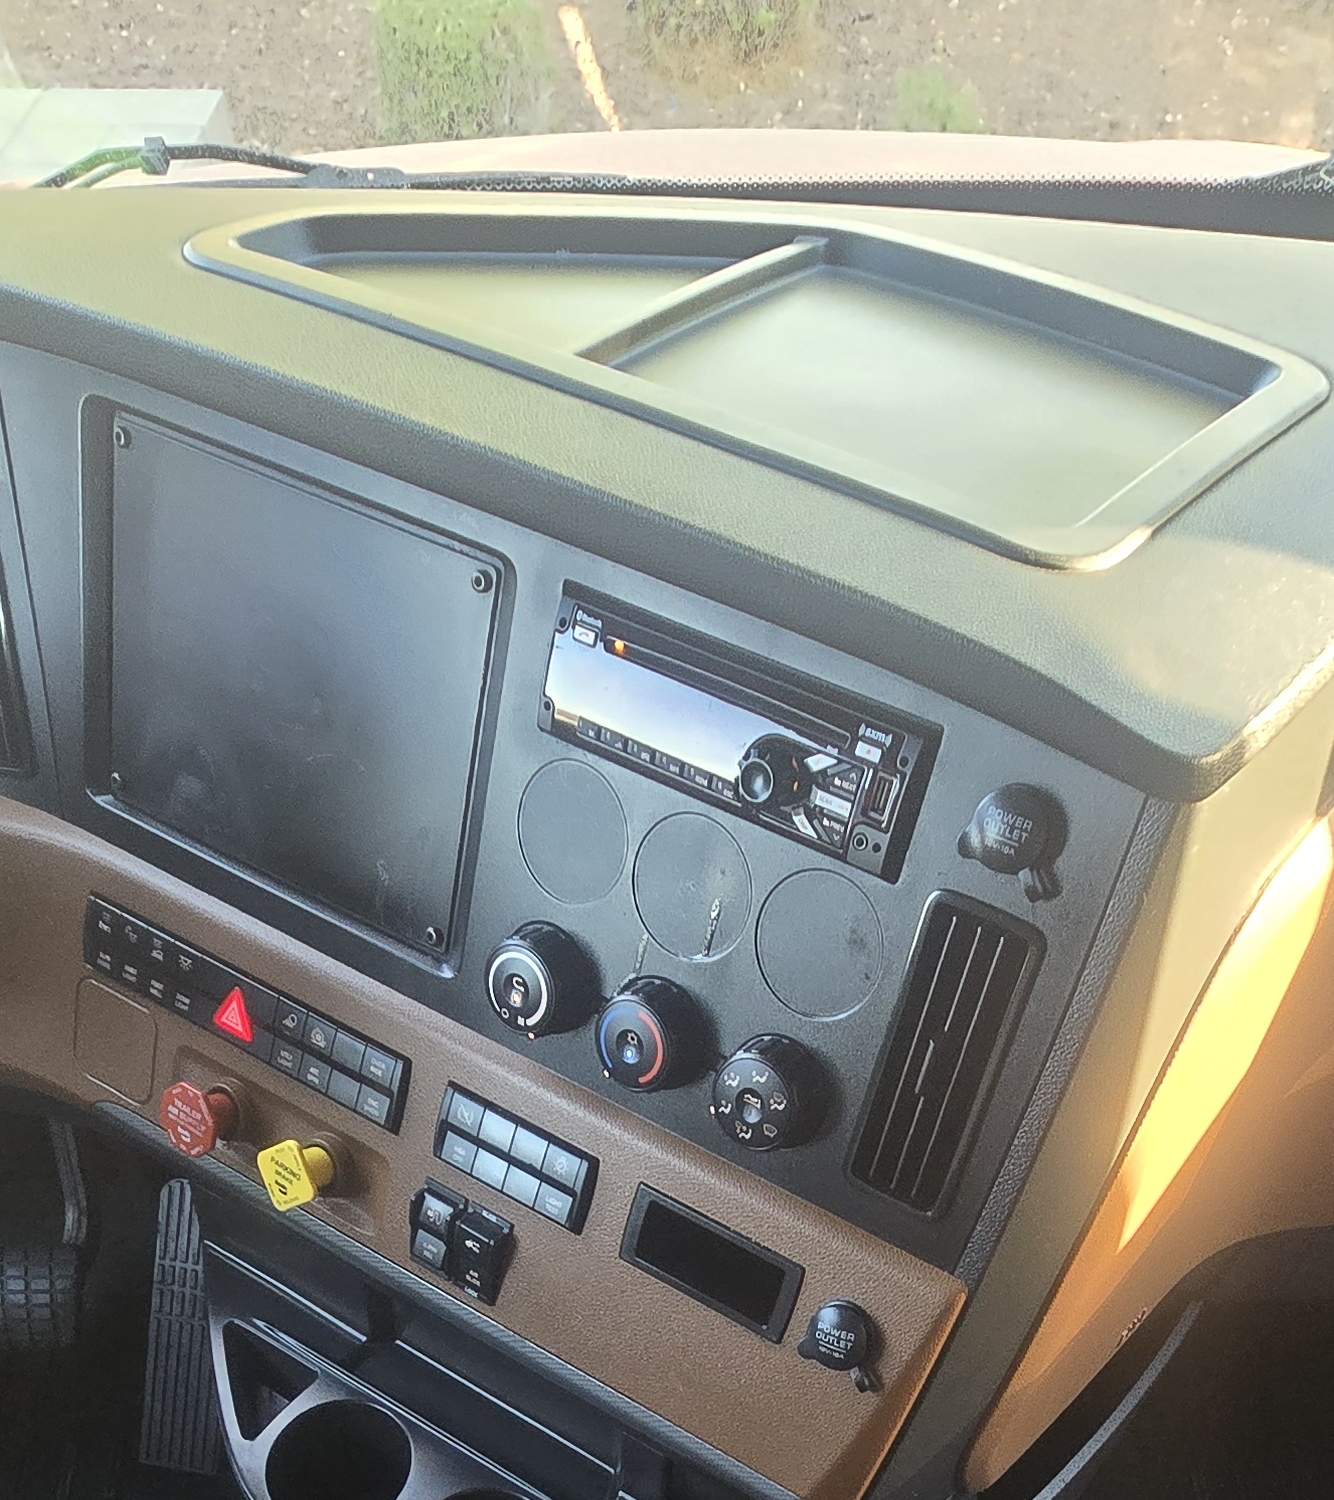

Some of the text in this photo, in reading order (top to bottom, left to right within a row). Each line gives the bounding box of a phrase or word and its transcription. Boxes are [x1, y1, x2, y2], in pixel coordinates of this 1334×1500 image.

[983, 817, 1029, 844] OUTLET
[987, 805, 1033, 832] POWER
[270, 1155, 302, 1181] PARKING
[815, 1330, 854, 1350] OUTLET
[817, 1320, 855, 1342] POWER
